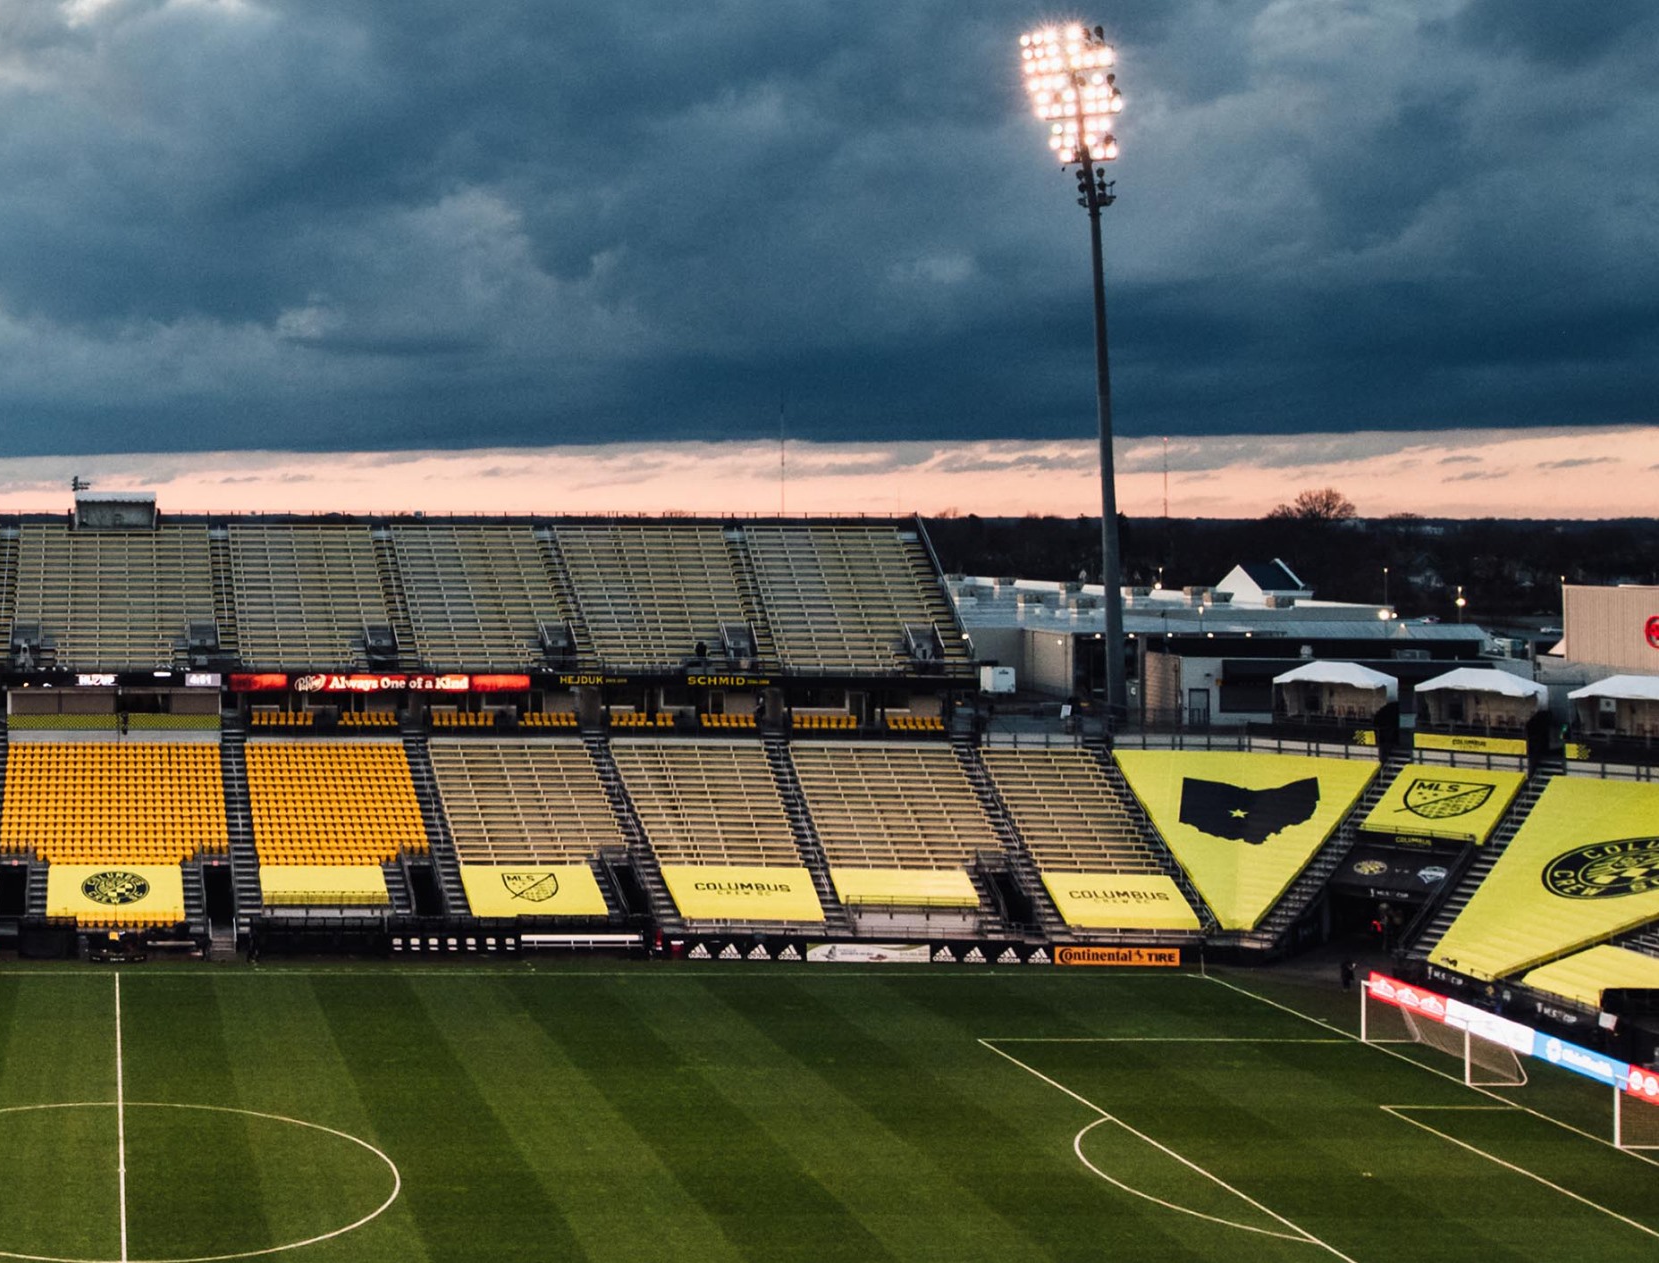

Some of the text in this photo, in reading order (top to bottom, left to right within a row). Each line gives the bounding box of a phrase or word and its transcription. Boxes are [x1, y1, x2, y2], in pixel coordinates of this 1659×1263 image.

[329, 676, 379, 691] Always
[380, 677, 406, 690] One
[408, 676, 424, 689] of
[425, 679, 434, 689] a
[435, 676, 470, 690] Kind
[559, 676, 604, 684] HEJDUK
[687, 676, 746, 685] SCHMID
[1416, 781, 1461, 793] MLS
[694, 882, 792, 893] COLUMBUS
[1553, 870, 1607, 896] CREW
[1068, 889, 1170, 901] COLUMBUS
[1058, 947, 1176, 964] Continental TIRE
